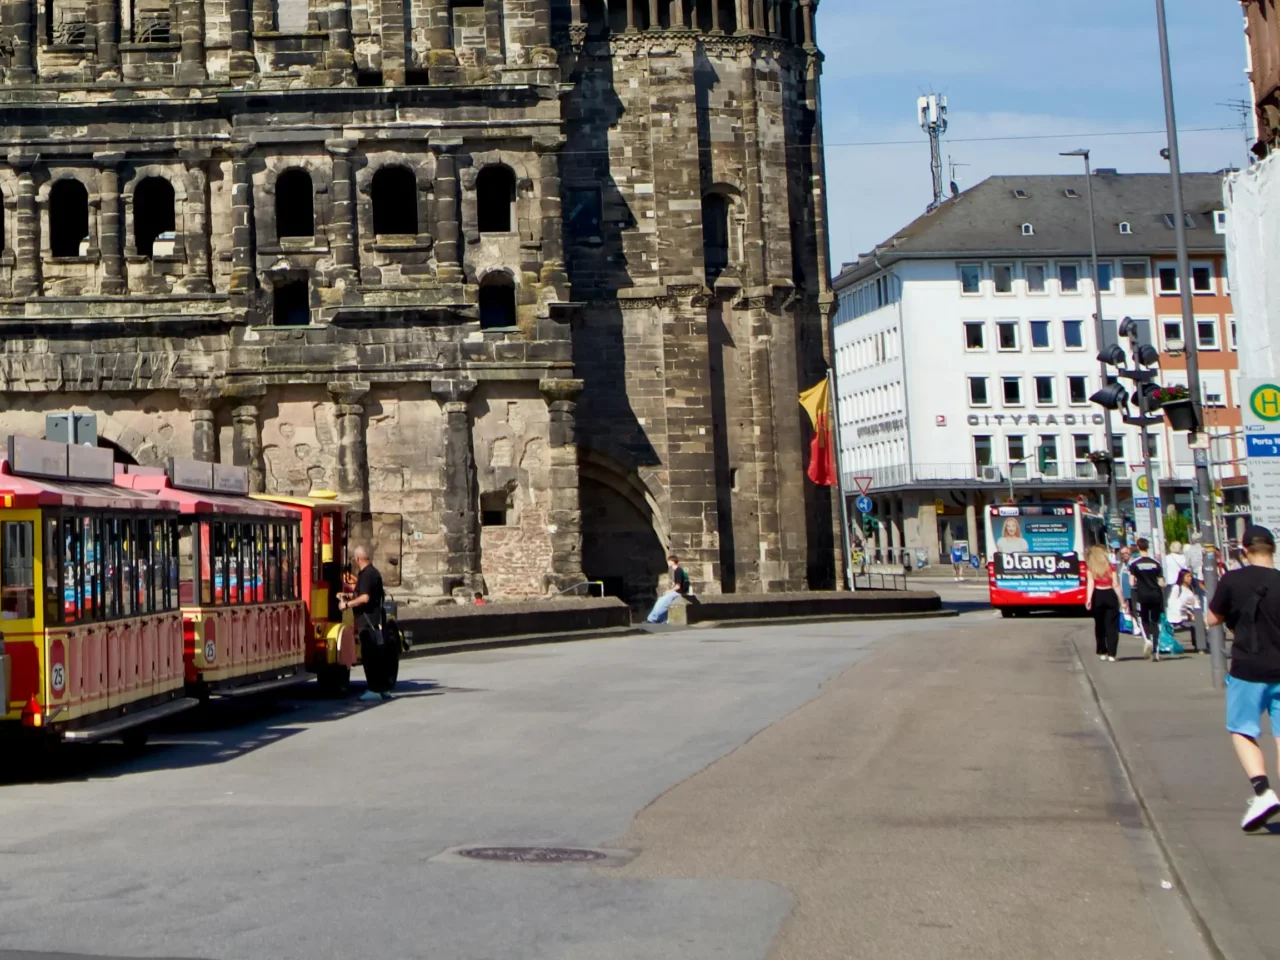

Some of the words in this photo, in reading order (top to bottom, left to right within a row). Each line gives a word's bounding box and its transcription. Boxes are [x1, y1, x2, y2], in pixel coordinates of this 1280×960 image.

[967, 414, 1105, 426] CITYRADIO
[1252, 437, 1273, 446] Porta
[1002, 552, 1071, 573] blang.de
[206, 643, 214, 658] 25
[54, 667, 63, 685] 25
